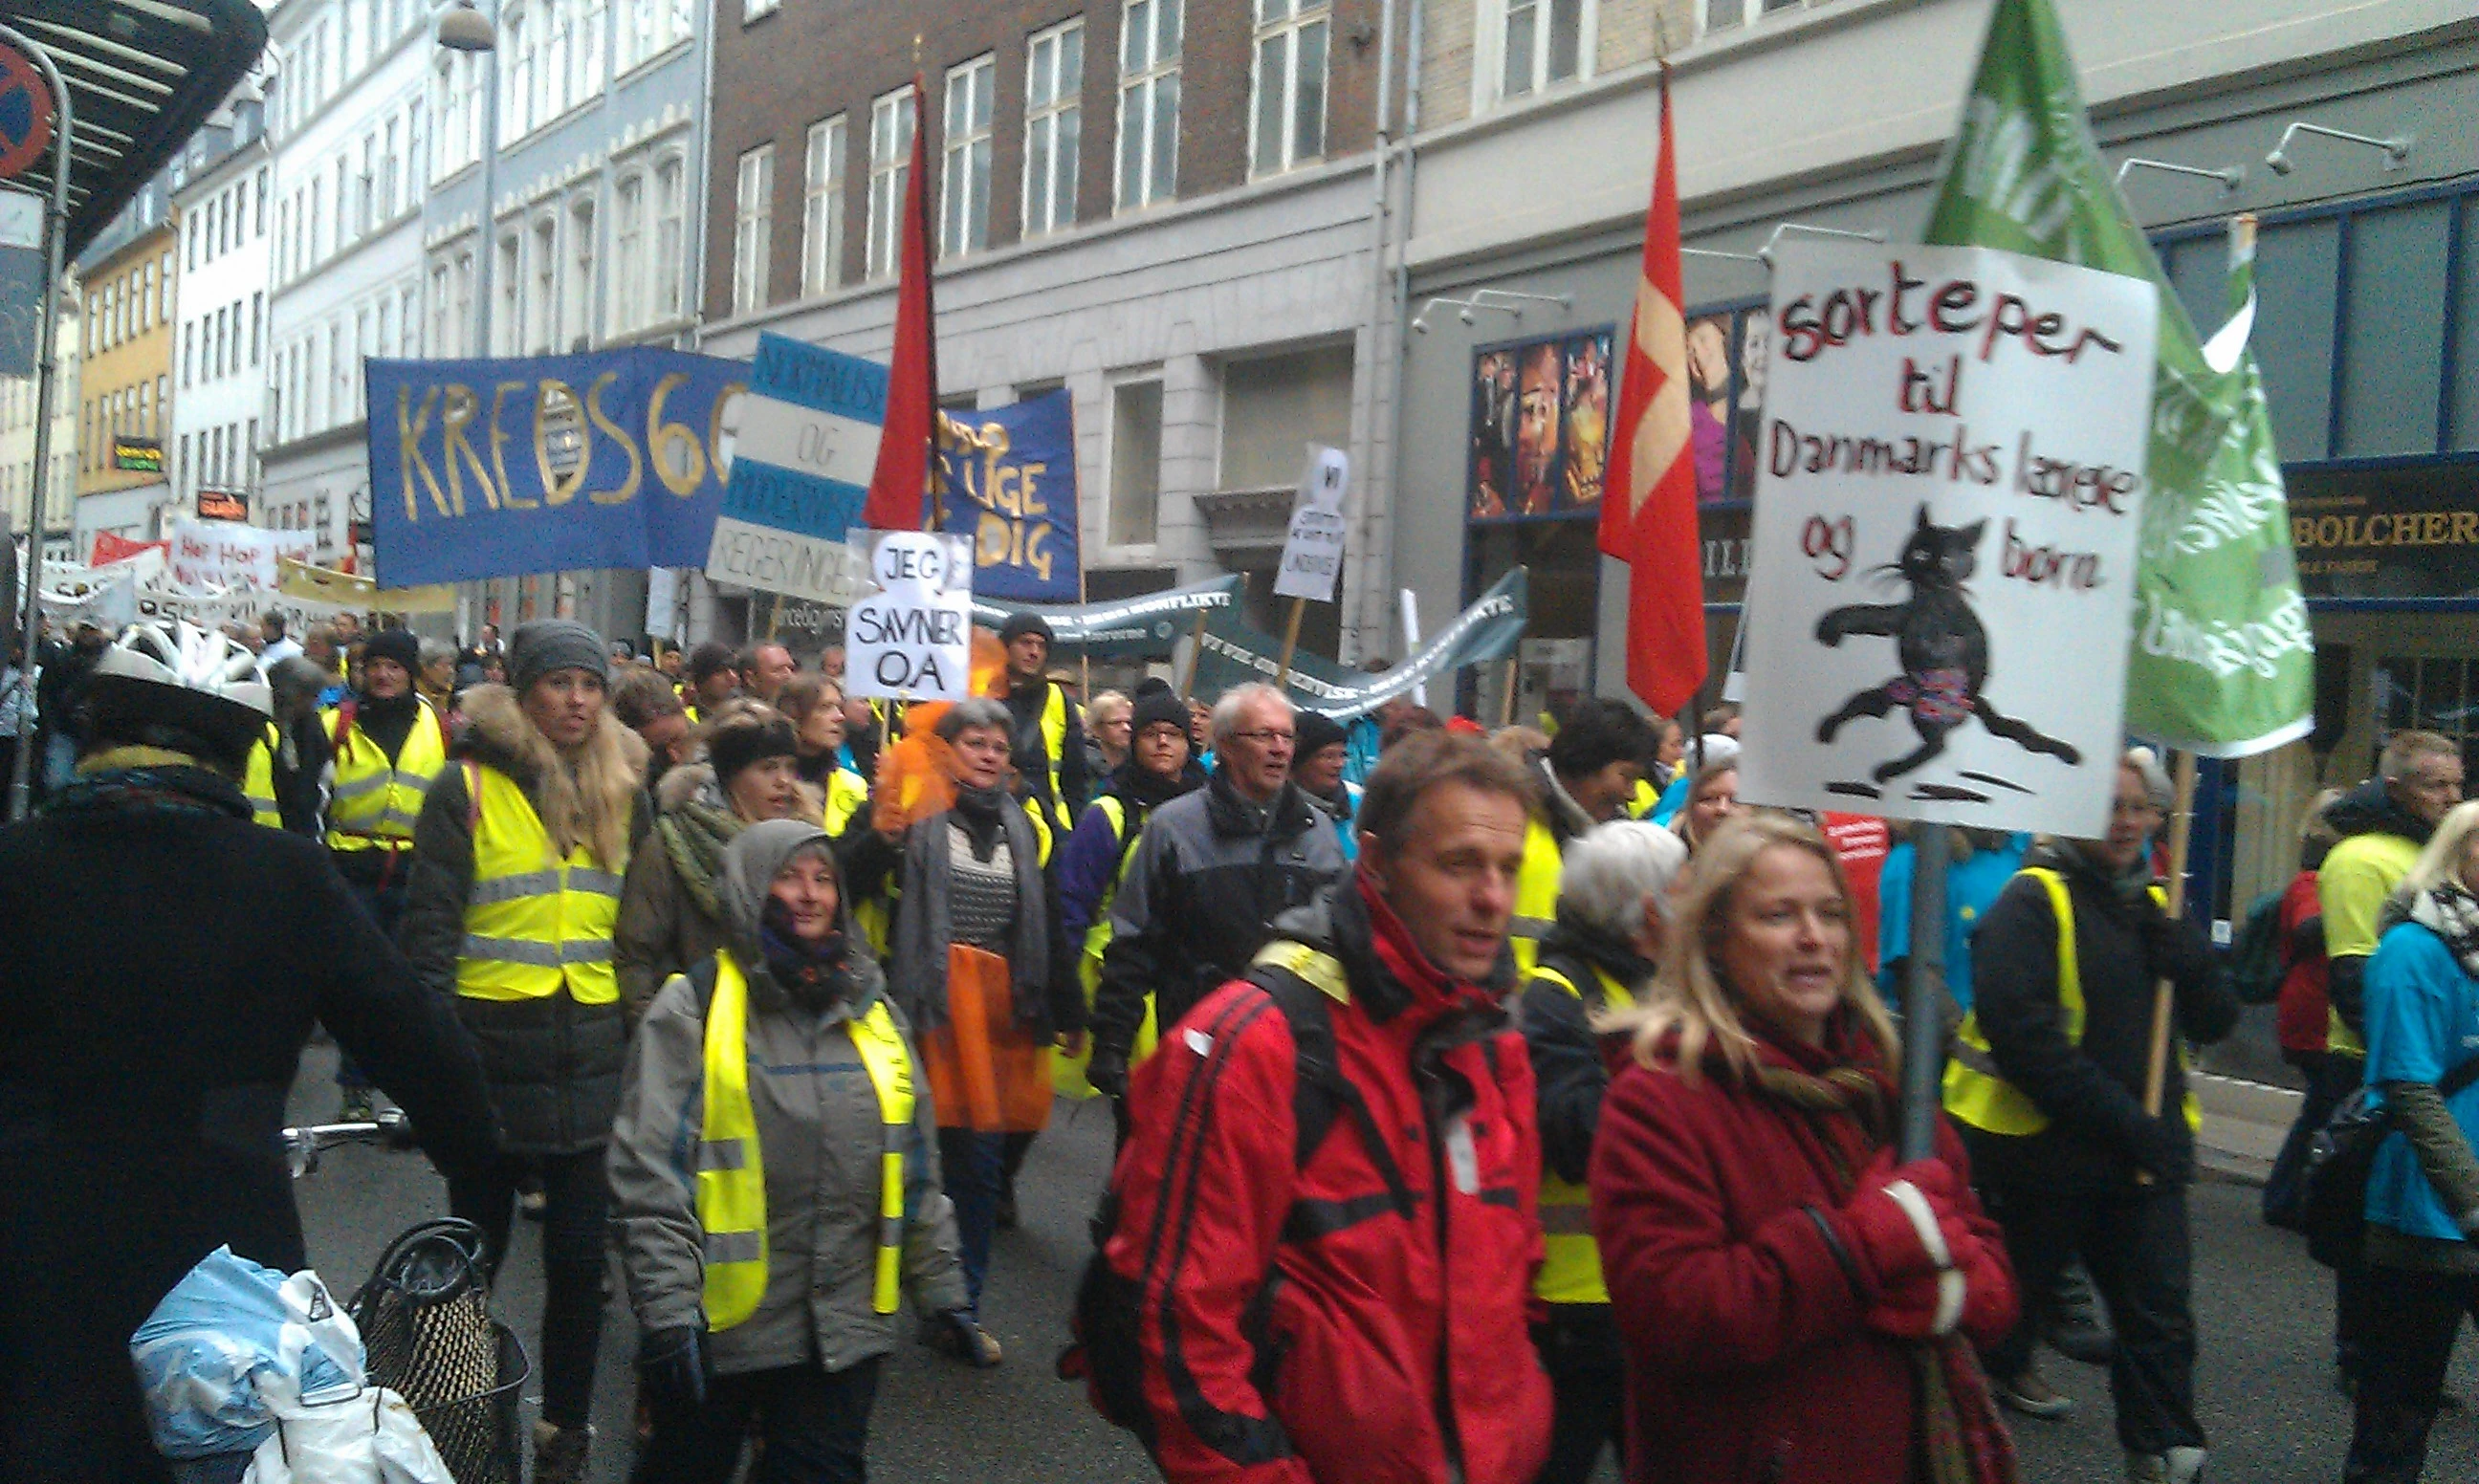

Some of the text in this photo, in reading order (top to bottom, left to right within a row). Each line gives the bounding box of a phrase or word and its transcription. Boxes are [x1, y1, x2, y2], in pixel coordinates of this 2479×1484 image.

[1779, 260, 2122, 364] sorteper
[1899, 353, 1961, 417] til
[398, 371, 643, 522] KREDS
[798, 423, 841, 467] OG
[1767, 417, 2001, 484] Danmarks
[720, 528, 867, 598] REGERINGE
[885, 545, 942, 581] JEG
[976, 511, 1052, 581] DIG
[1801, 513, 1854, 581] og
[856, 605, 965, 647] SAVNER
[877, 650, 946, 691] OA
